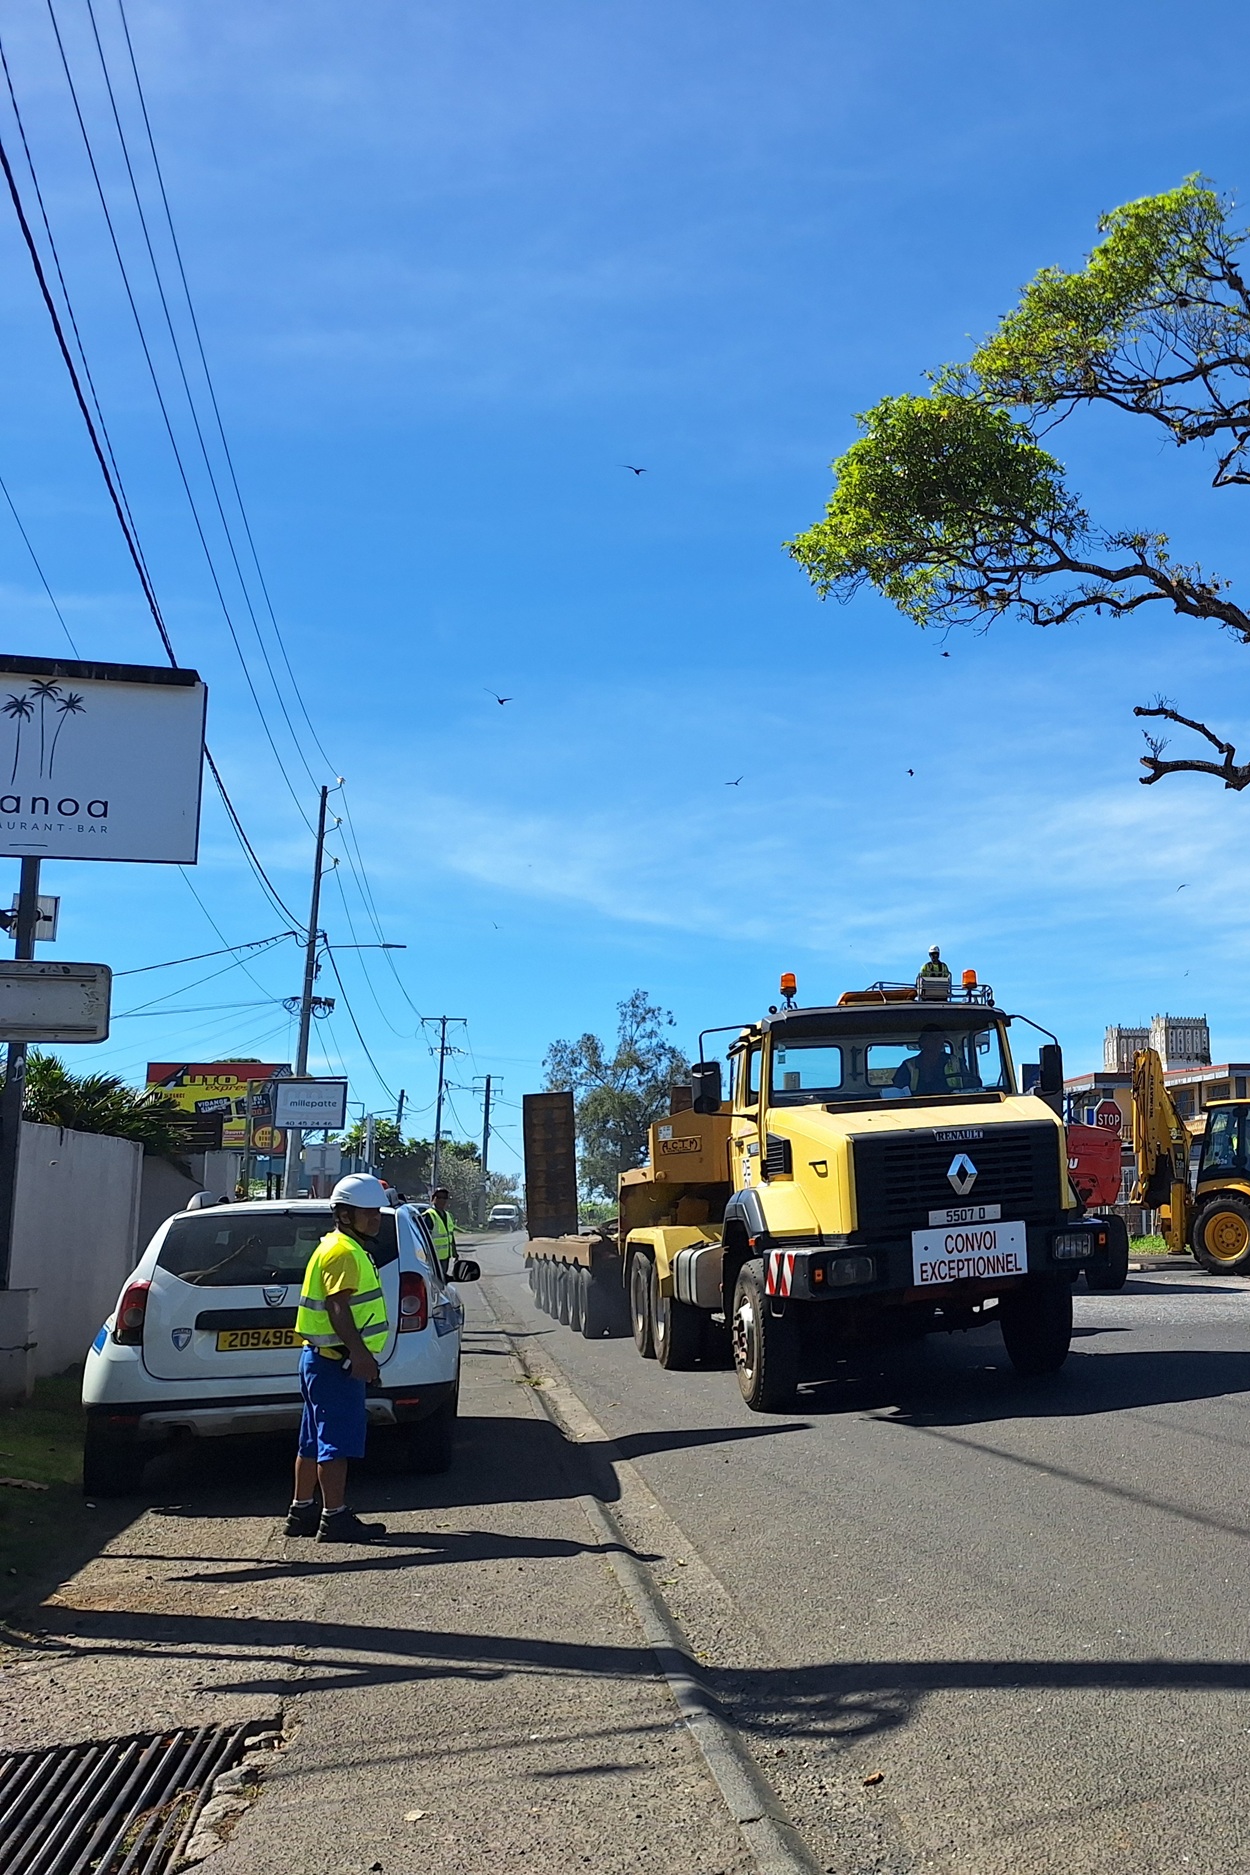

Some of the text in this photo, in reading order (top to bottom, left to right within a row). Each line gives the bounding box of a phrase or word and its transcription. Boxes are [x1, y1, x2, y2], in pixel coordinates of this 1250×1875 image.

[0, 795, 108, 818] anoa
[205, 1084, 248, 1092] expres
[290, 1099, 337, 1108] millepatte
[1098, 1114, 1120, 1126] STOP
[936, 1129, 984, 1142] RENAULT
[946, 1207, 986, 1223] 5507 D
[944, 1231, 997, 1254] CONVOI
[920, 1253, 1022, 1282] EXCEPTIONNEL
[228, 1330, 295, 1348] 209496
